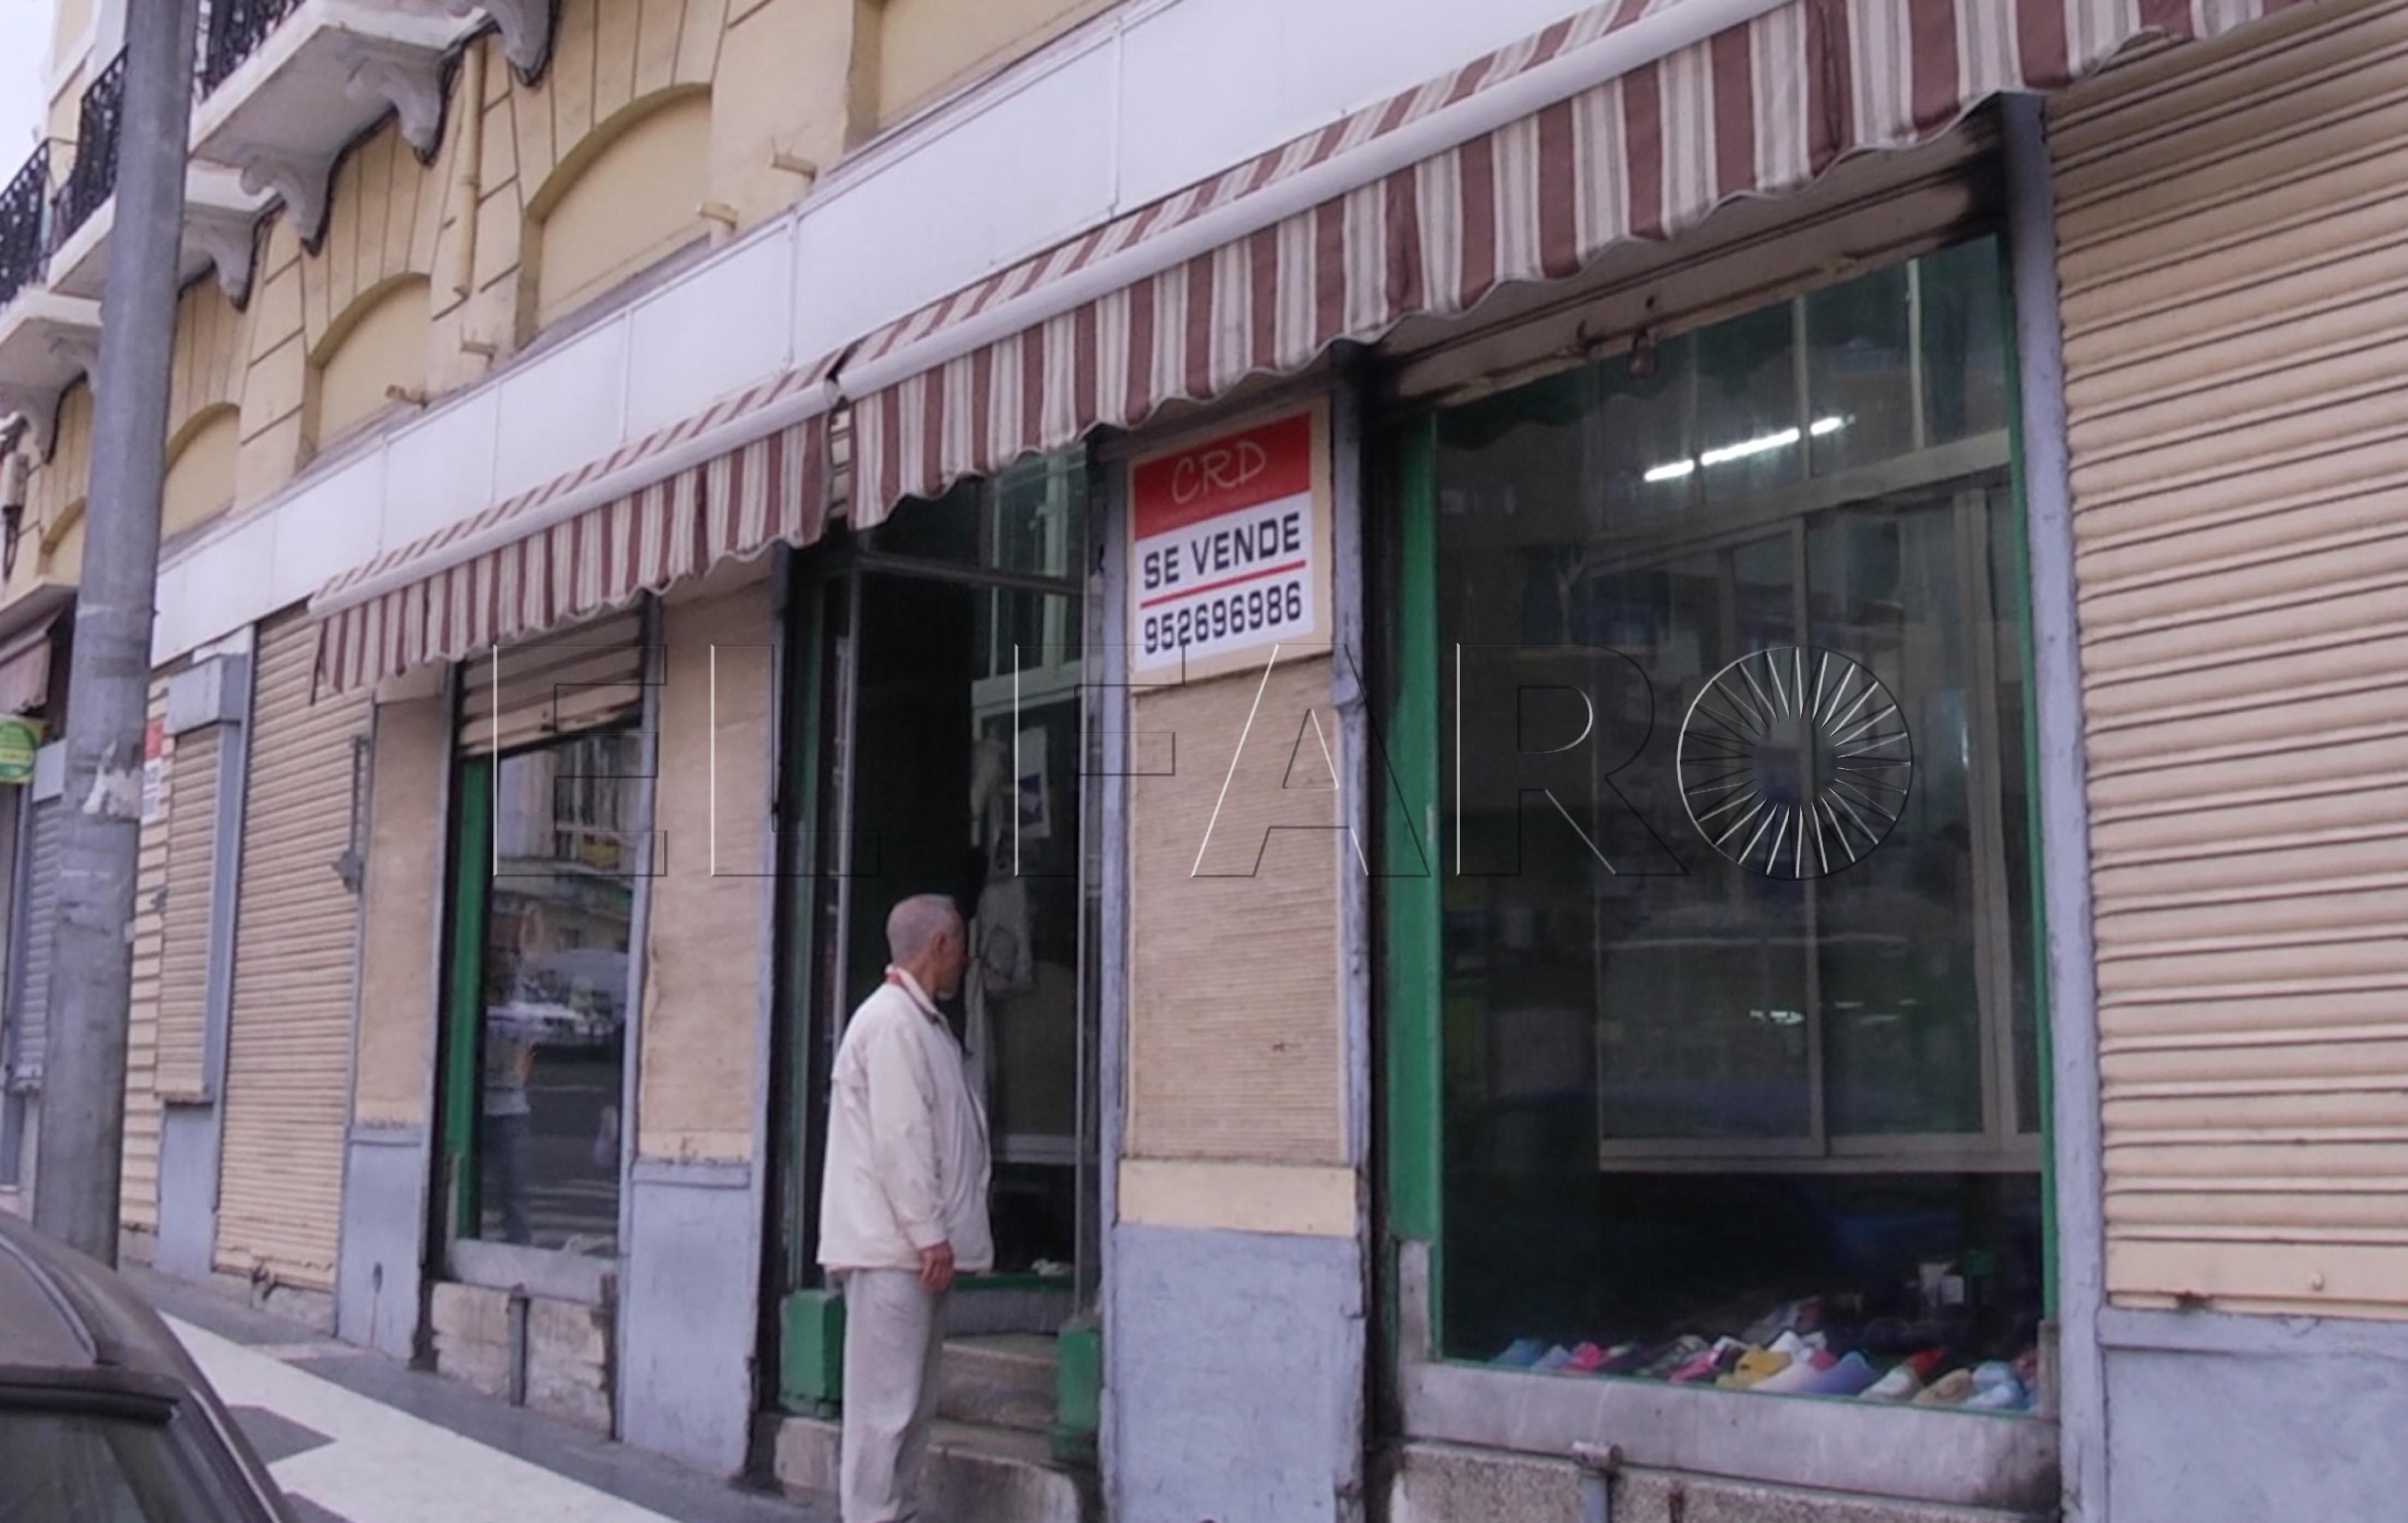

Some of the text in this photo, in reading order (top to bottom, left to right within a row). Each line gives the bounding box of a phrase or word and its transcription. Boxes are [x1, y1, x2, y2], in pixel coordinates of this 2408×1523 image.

[1171, 441, 1266, 504] CRD
[1143, 511, 1301, 591] SE VENDE
[1144, 580, 1302, 655] 952696986
